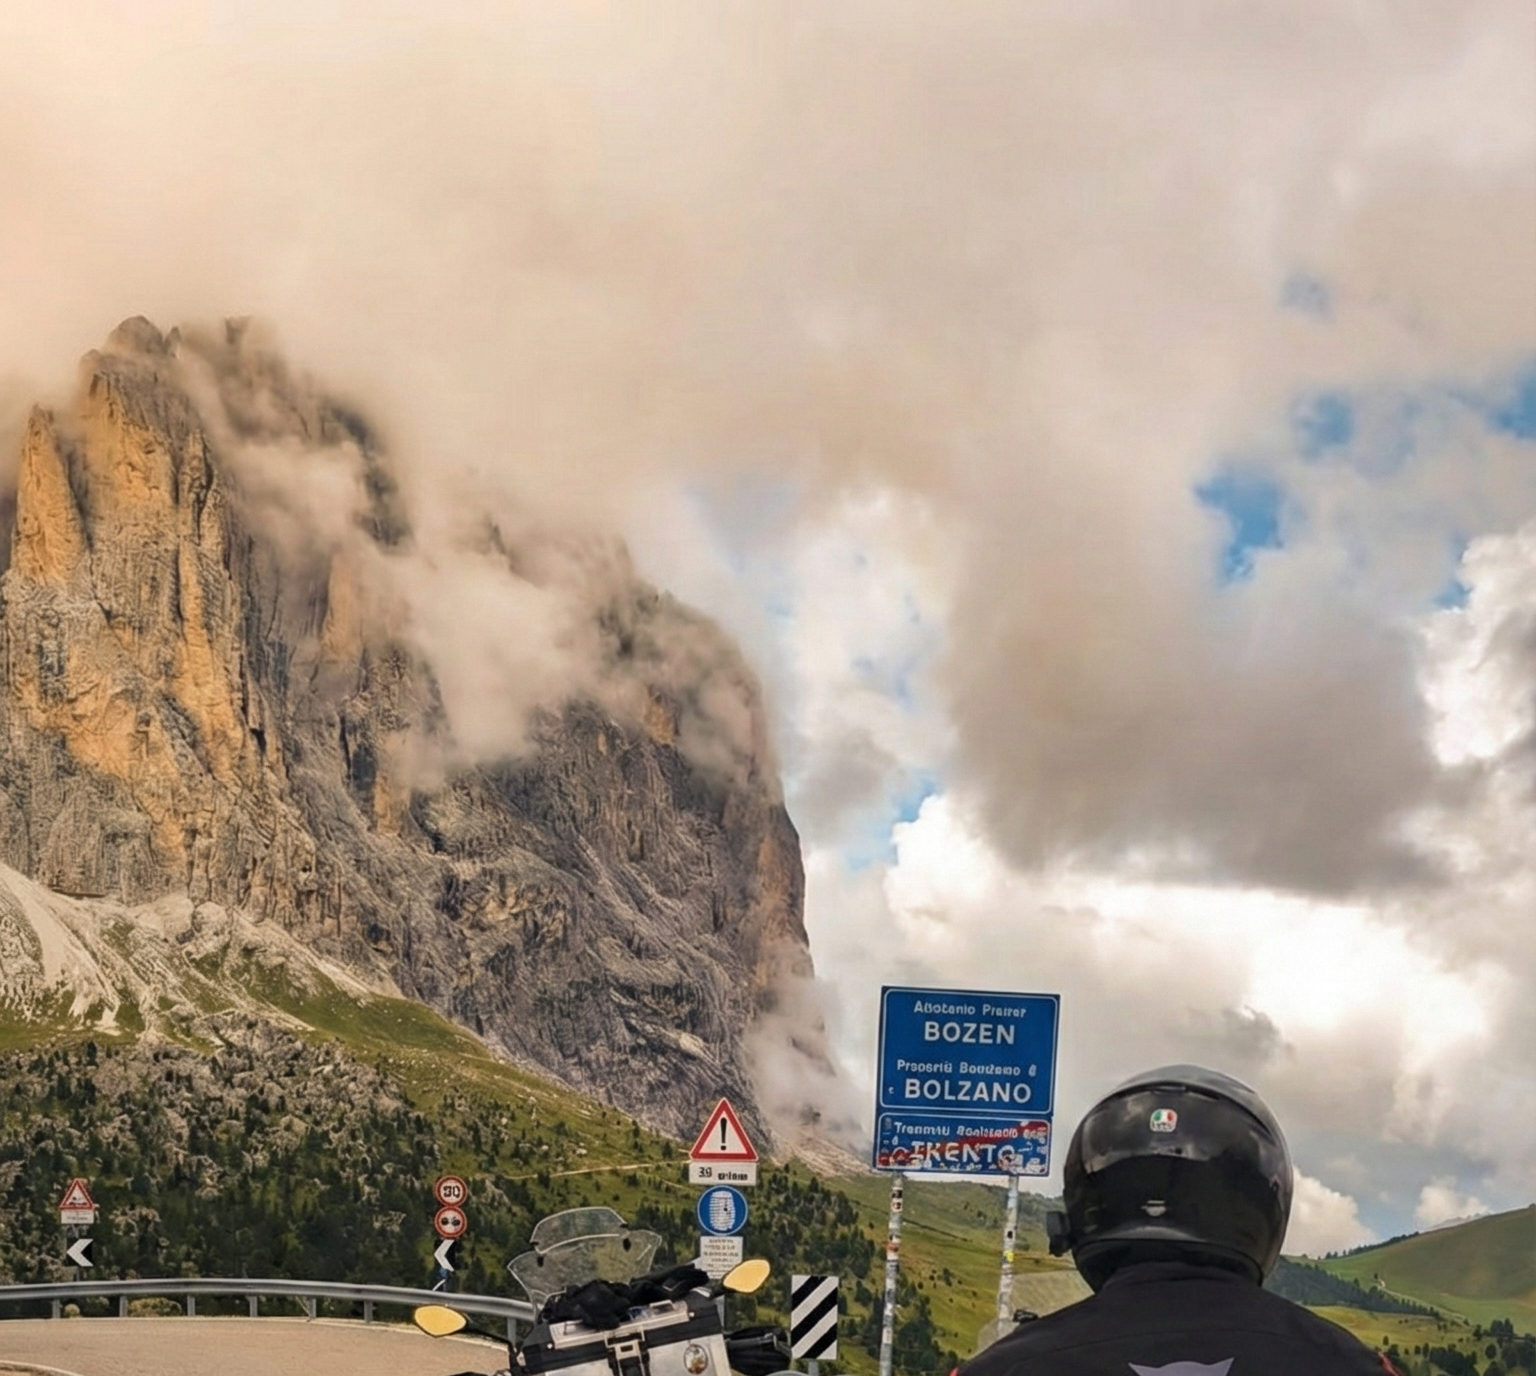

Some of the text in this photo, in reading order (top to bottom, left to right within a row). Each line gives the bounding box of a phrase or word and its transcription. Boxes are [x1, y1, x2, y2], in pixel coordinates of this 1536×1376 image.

[924, 1021, 1015, 1045] BOZEN
[904, 1078, 1032, 1104] BOLZANO
[443, 1185, 461, 1199] 30
